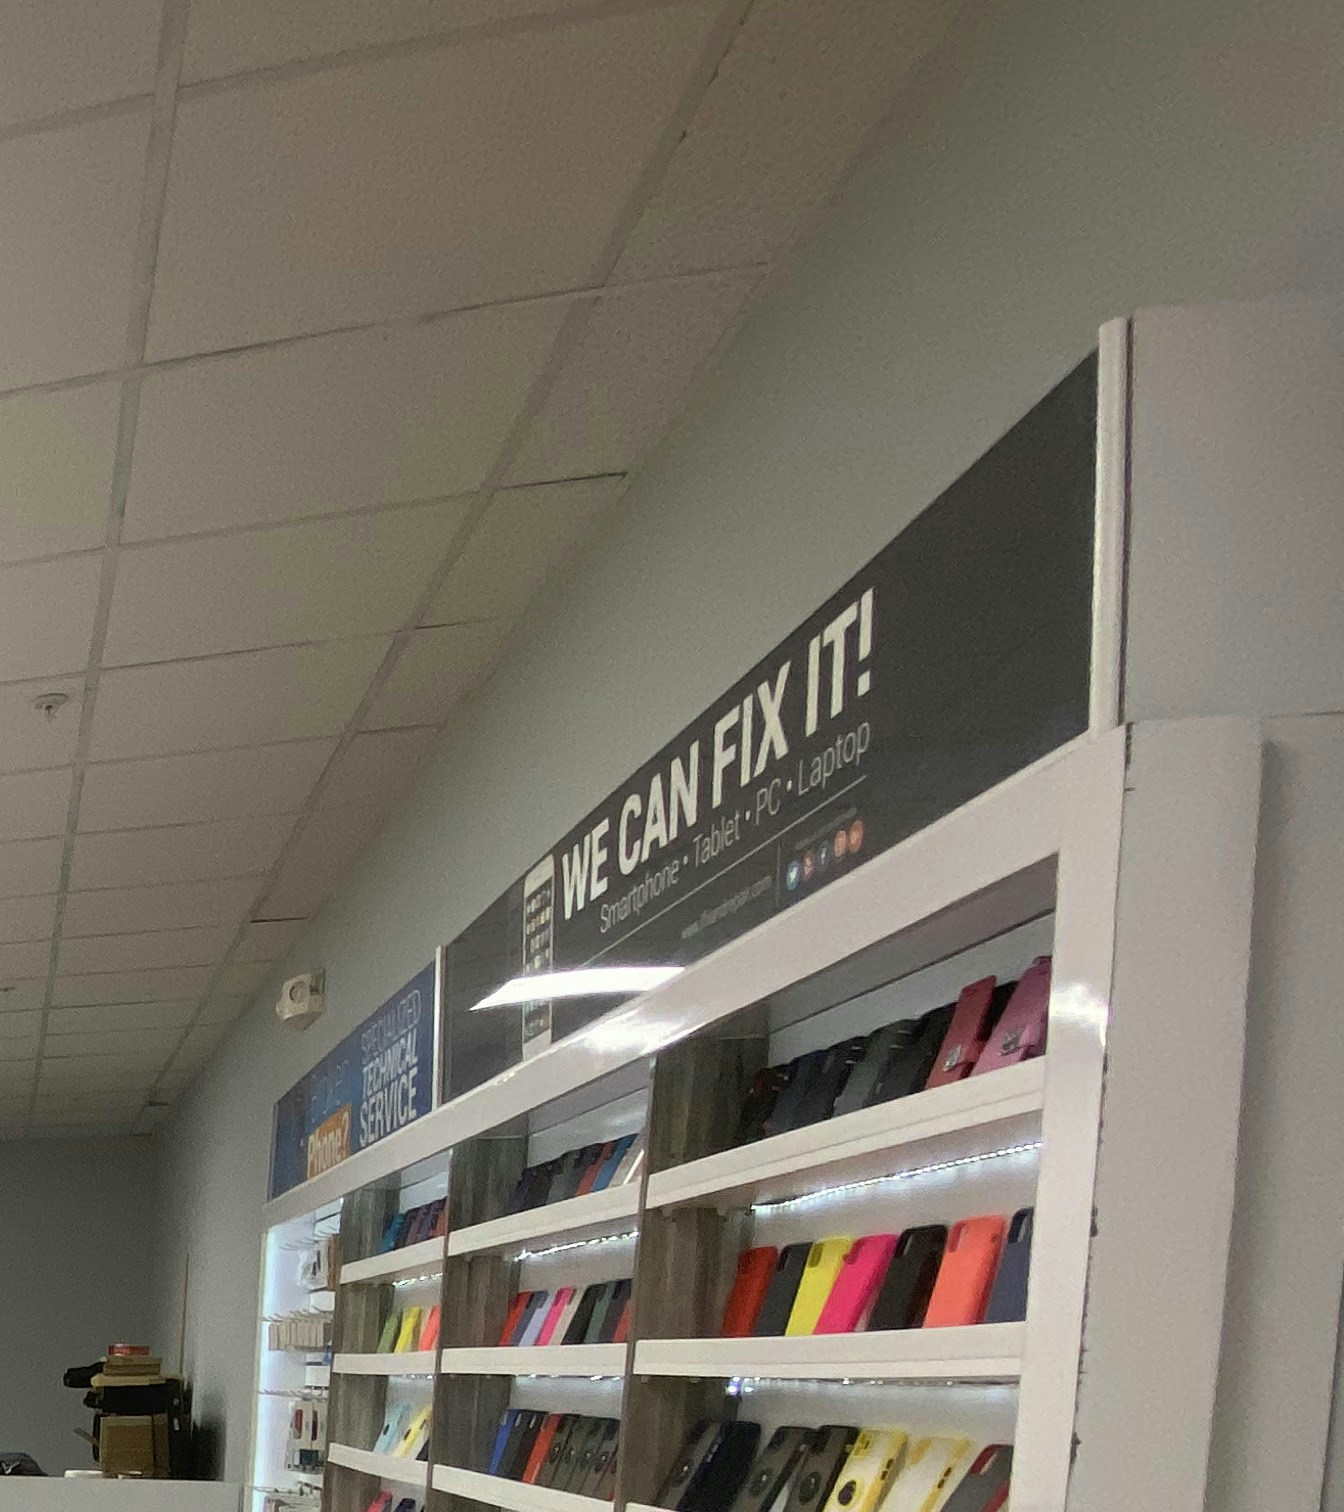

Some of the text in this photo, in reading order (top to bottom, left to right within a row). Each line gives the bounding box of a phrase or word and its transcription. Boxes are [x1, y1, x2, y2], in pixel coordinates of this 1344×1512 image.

[562, 586, 874, 920] WE CAN FIX IT!
[600, 861, 680, 933] Smartphone
[692, 810, 740, 869] Tablet
[755, 777, 782, 826] PC
[797, 721, 871, 797] Laptop
[359, 1066, 417, 1148] SERVICE
[362, 1028, 418, 1100] TECHNICAL
